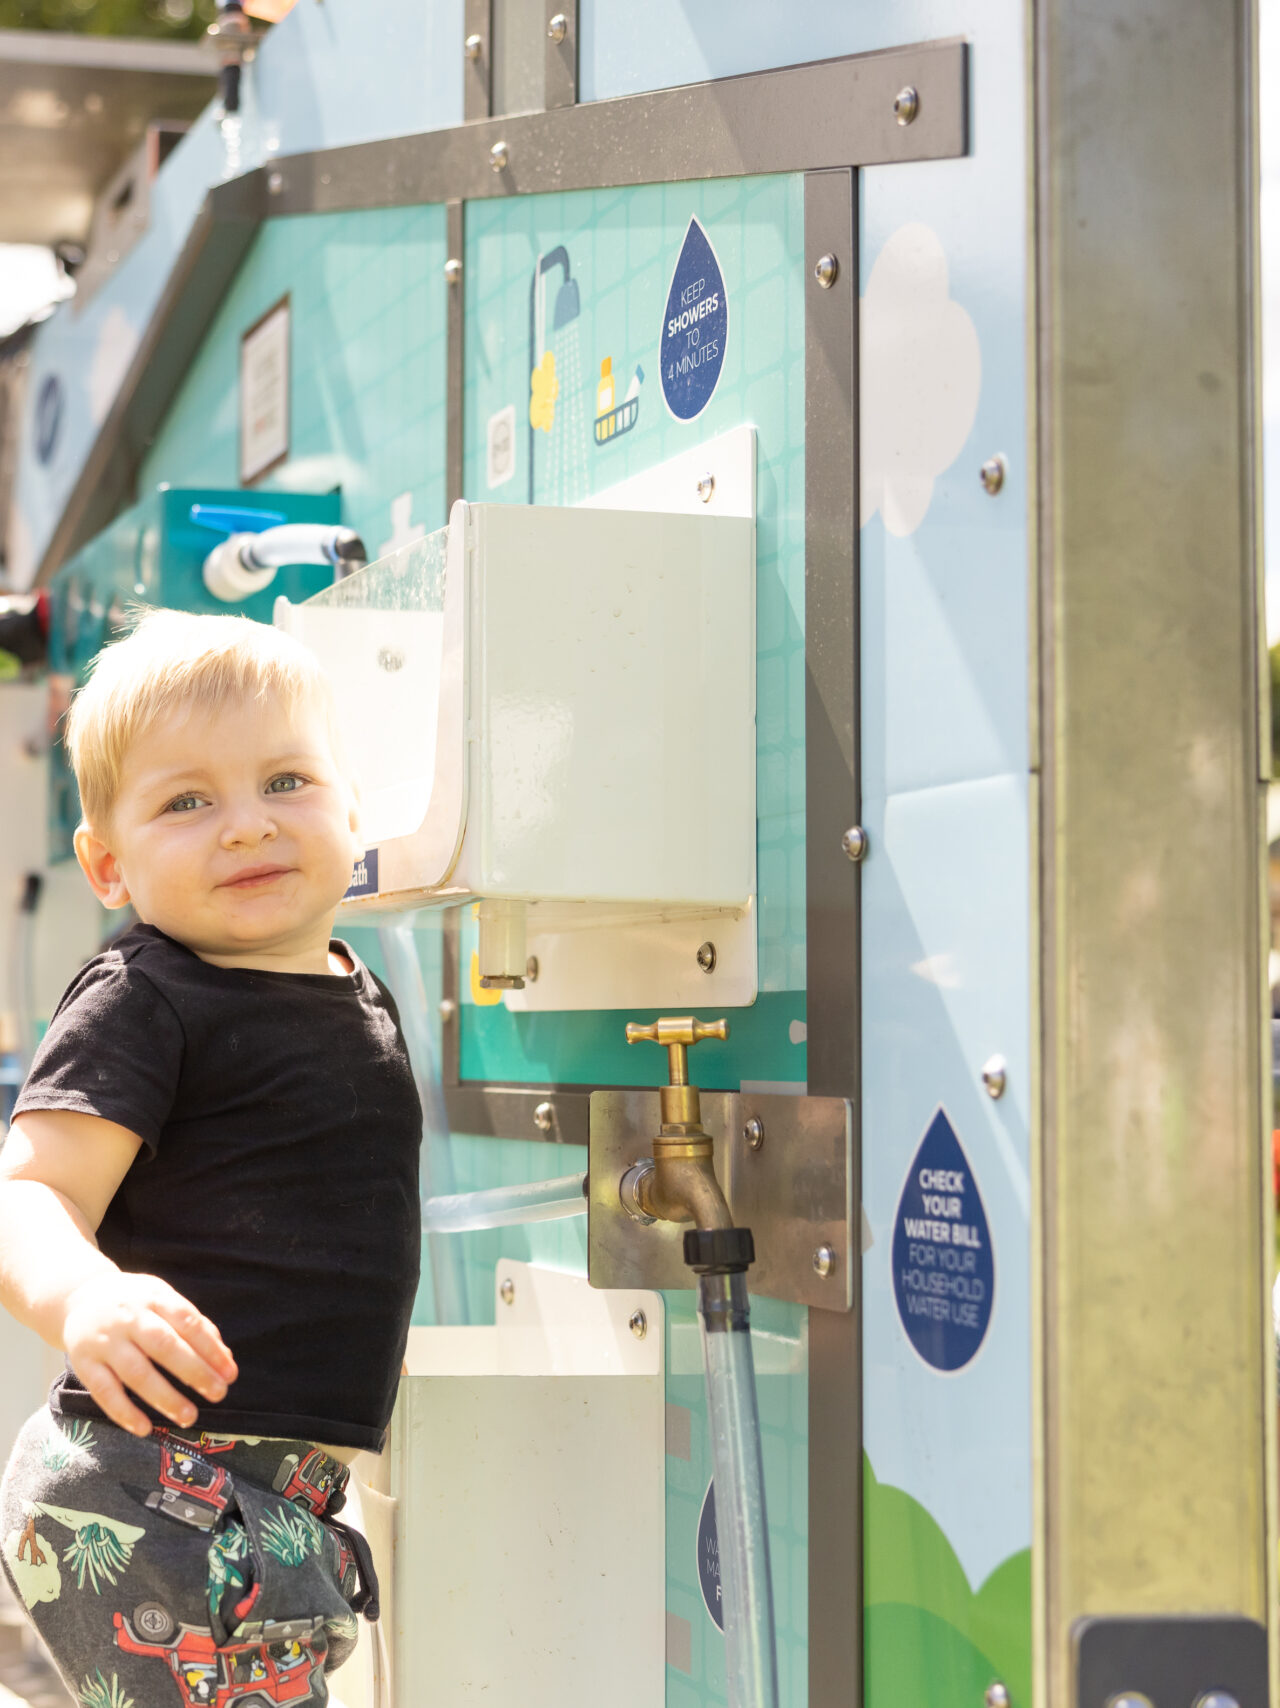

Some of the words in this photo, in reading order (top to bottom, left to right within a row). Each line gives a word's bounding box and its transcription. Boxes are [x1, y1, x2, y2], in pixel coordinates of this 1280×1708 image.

[681, 278, 705, 307] KEEP
[668, 293, 719, 338] SHOWERS
[686, 328, 700, 348] TO
[668, 364, 675, 381] 4
[676, 339, 719, 379] MINUTES
[348, 861, 368, 888] ath
[919, 1168, 965, 1194] CHECK
[921, 1194, 962, 1219] YOUR
[904, 1217, 950, 1243] WATER
[952, 1224, 981, 1248] BILL
[909, 1243, 936, 1268] FOR
[937, 1246, 976, 1273] YOUR
[902, 1268, 984, 1300] HOUSEHOLD
[906, 1293, 951, 1321] WATER
[951, 1301, 979, 1328] USE
